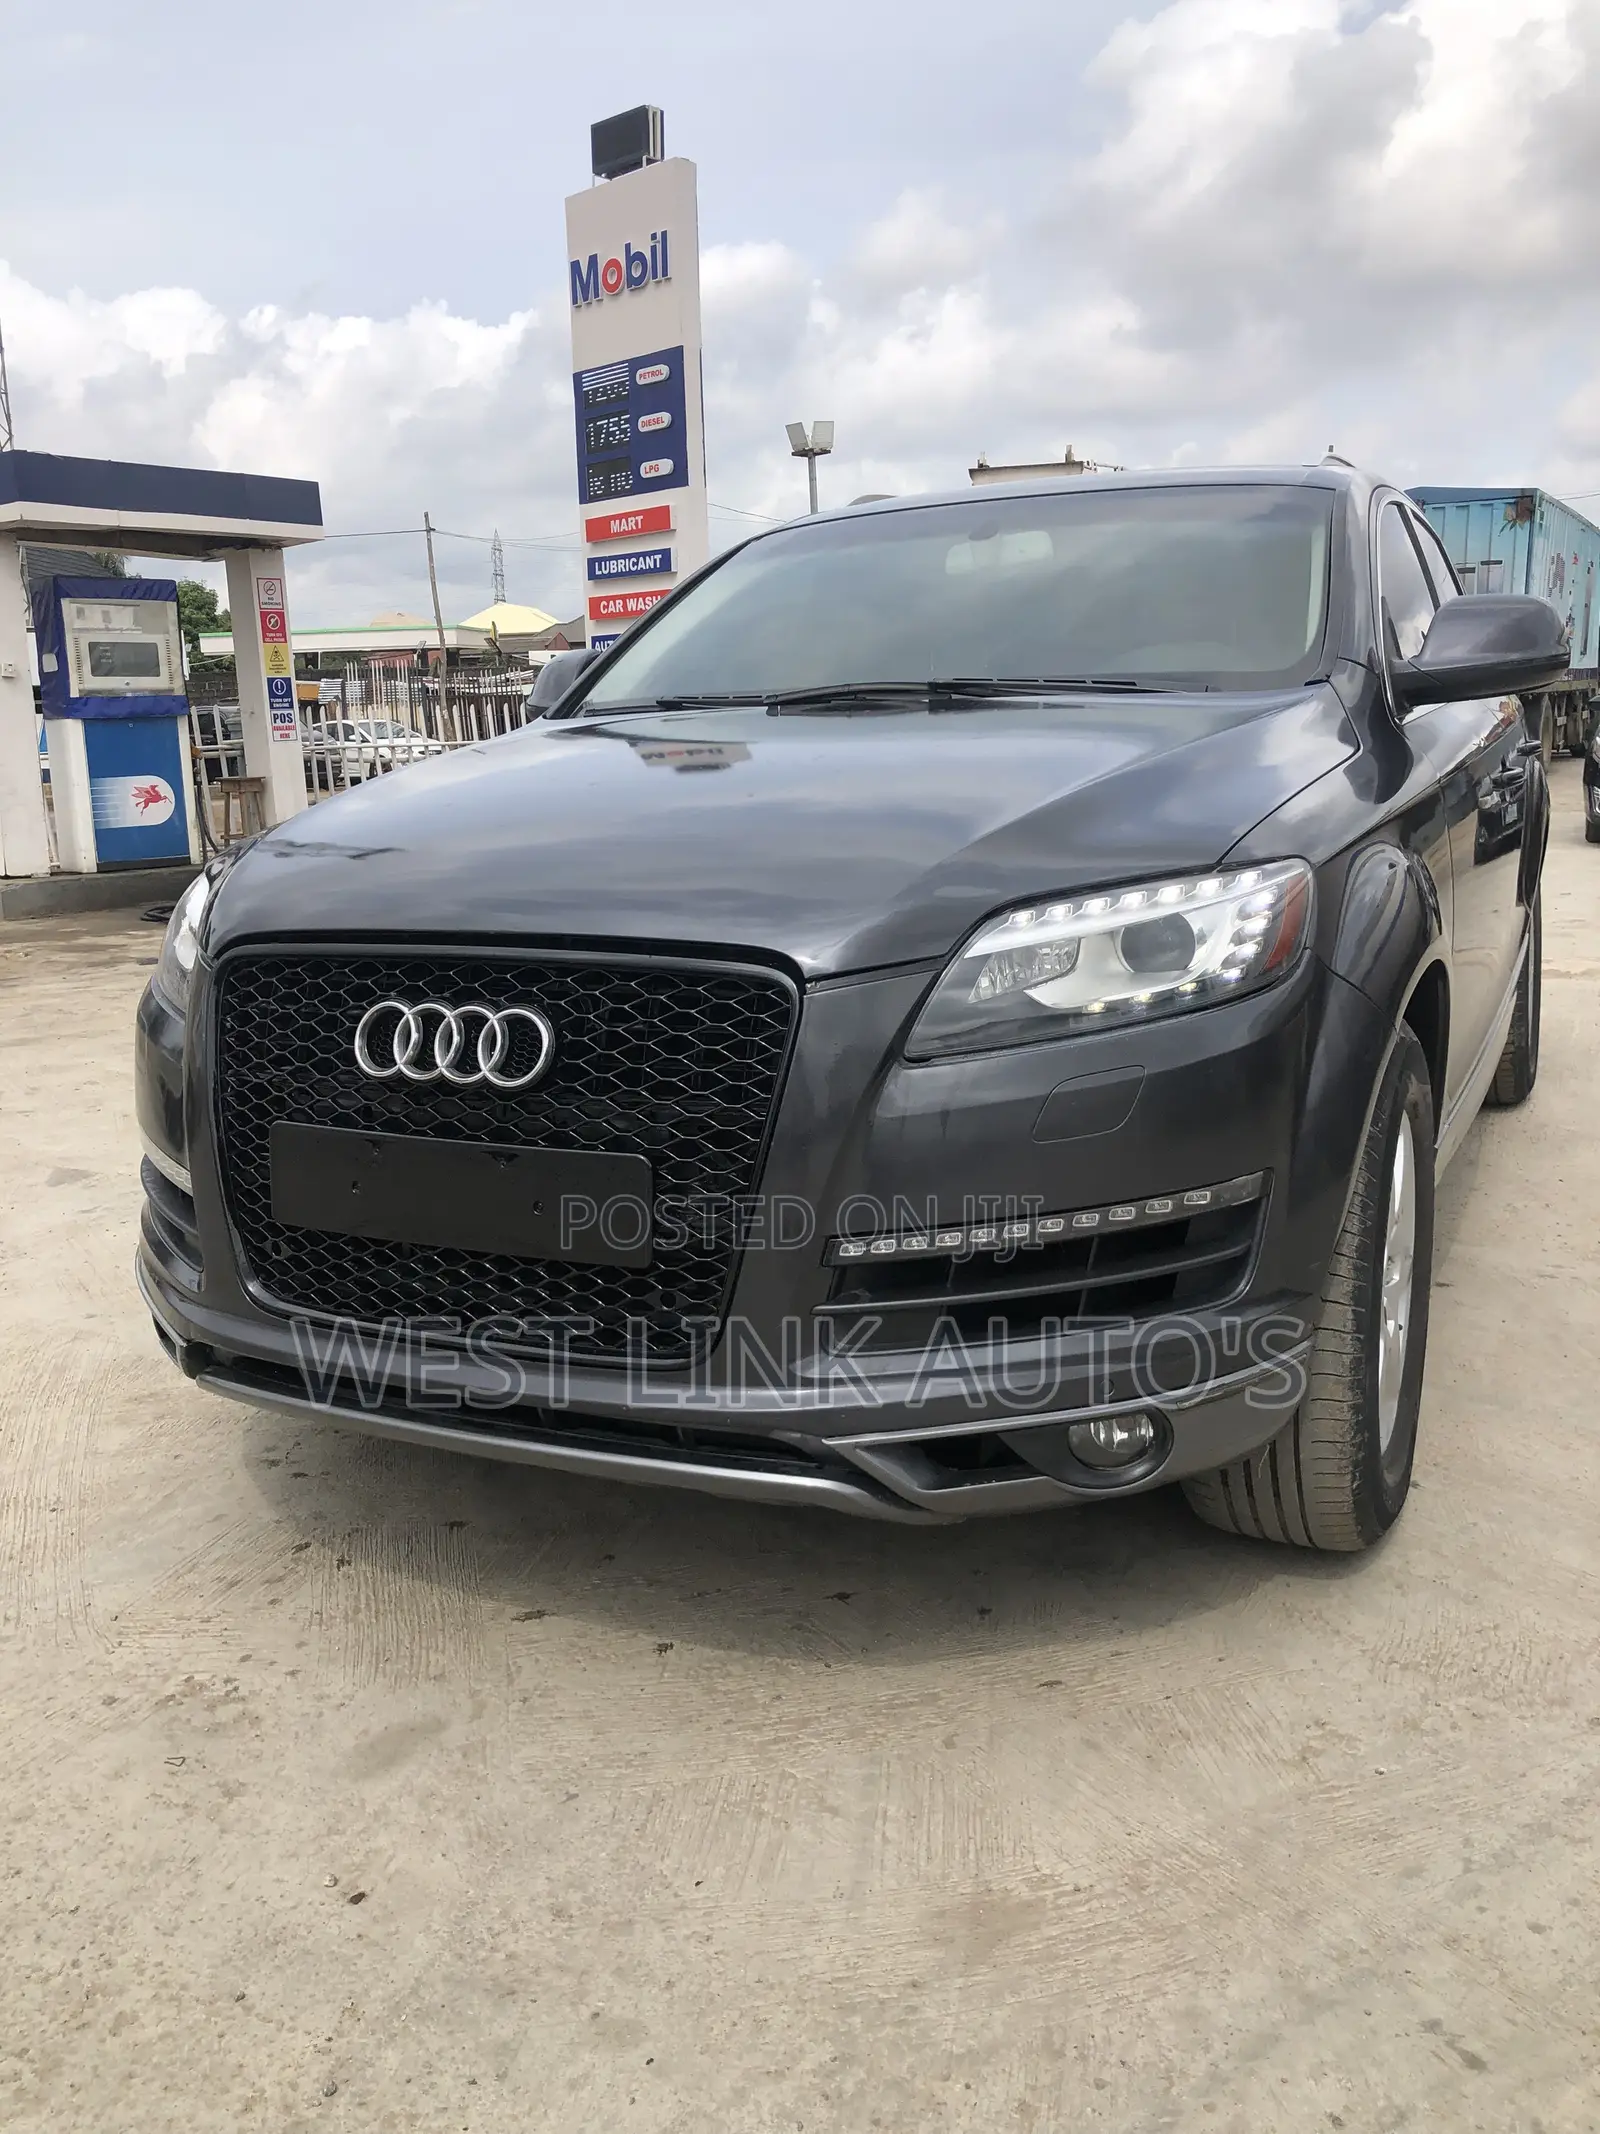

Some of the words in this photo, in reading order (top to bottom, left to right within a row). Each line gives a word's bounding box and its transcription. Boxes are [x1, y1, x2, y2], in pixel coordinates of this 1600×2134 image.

[570, 230, 669, 307] Mobil
[638, 368, 664, 381] PETROL
[641, 416, 665, 428] DIESEL
[644, 464, 660, 475] LPG
[610, 515, 644, 534] MART
[595, 554, 662, 575] LUBRICANT
[600, 599, 623, 614] CAR
[273, 712, 293, 724] POS
